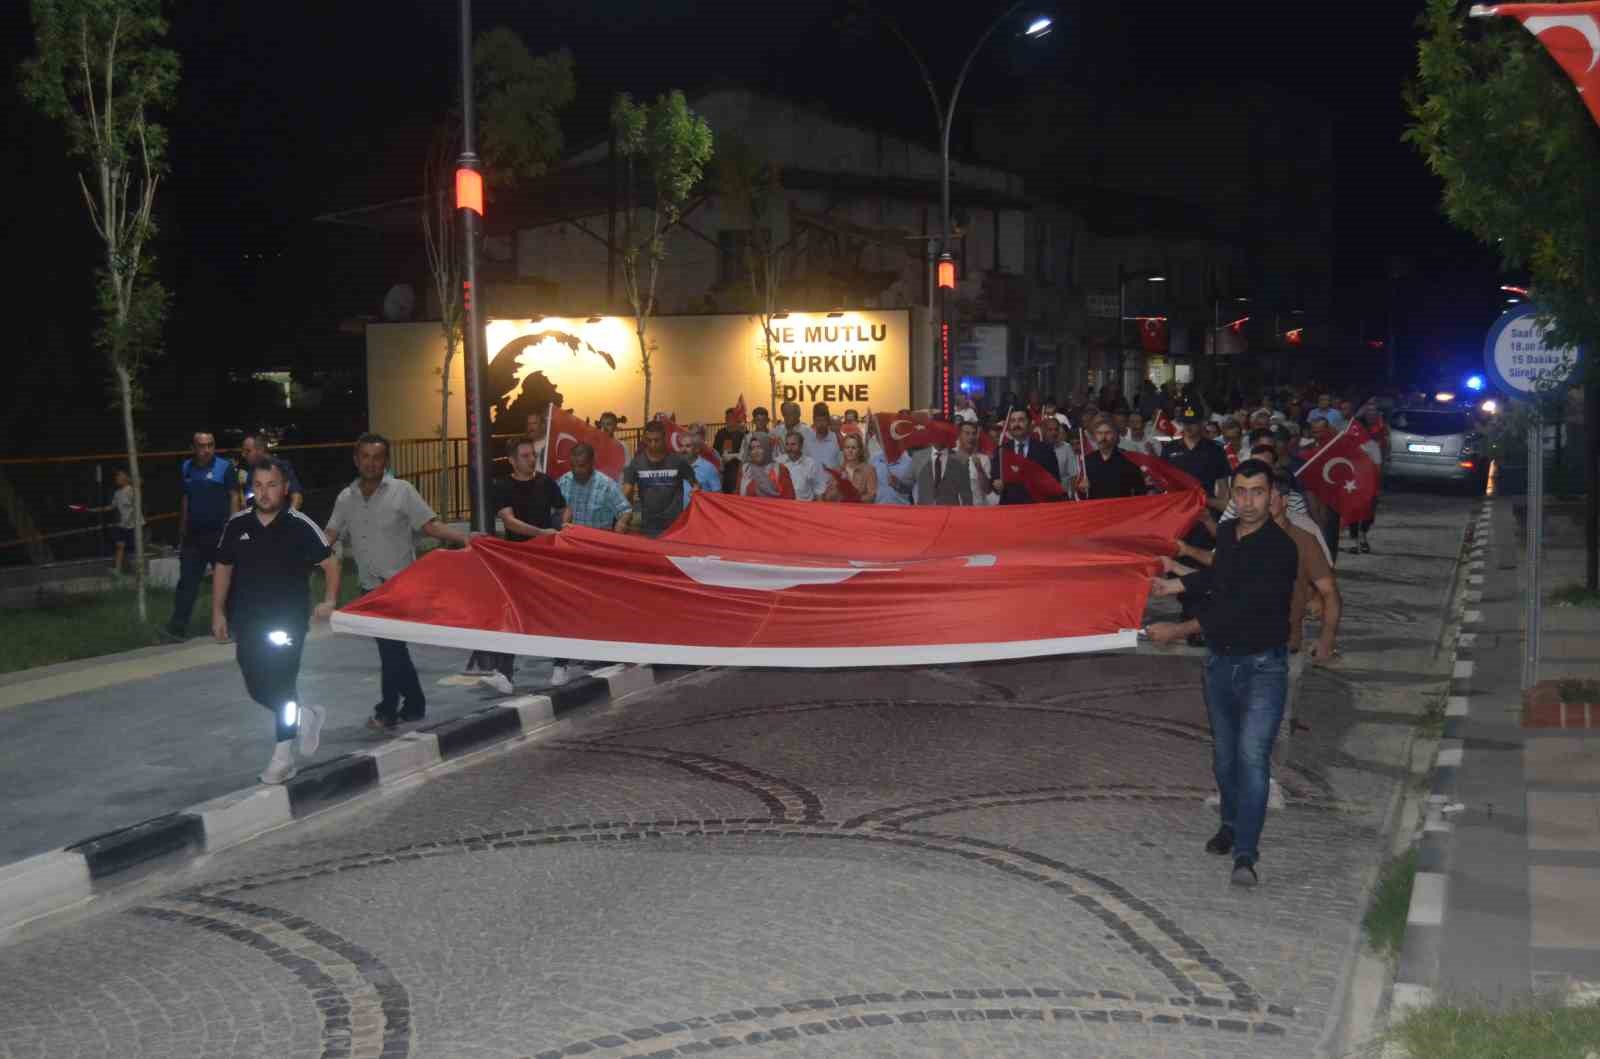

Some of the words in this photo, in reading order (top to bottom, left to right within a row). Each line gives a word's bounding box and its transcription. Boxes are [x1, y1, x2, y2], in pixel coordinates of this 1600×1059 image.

[768, 327, 794, 343] NE
[805, 324, 887, 343] MUTLU
[775, 350, 877, 373] TÜRKÜM
[1512, 355, 1524, 364] 15
[1526, 354, 1561, 364] Dakika
[783, 380, 869, 402] DİYENE
